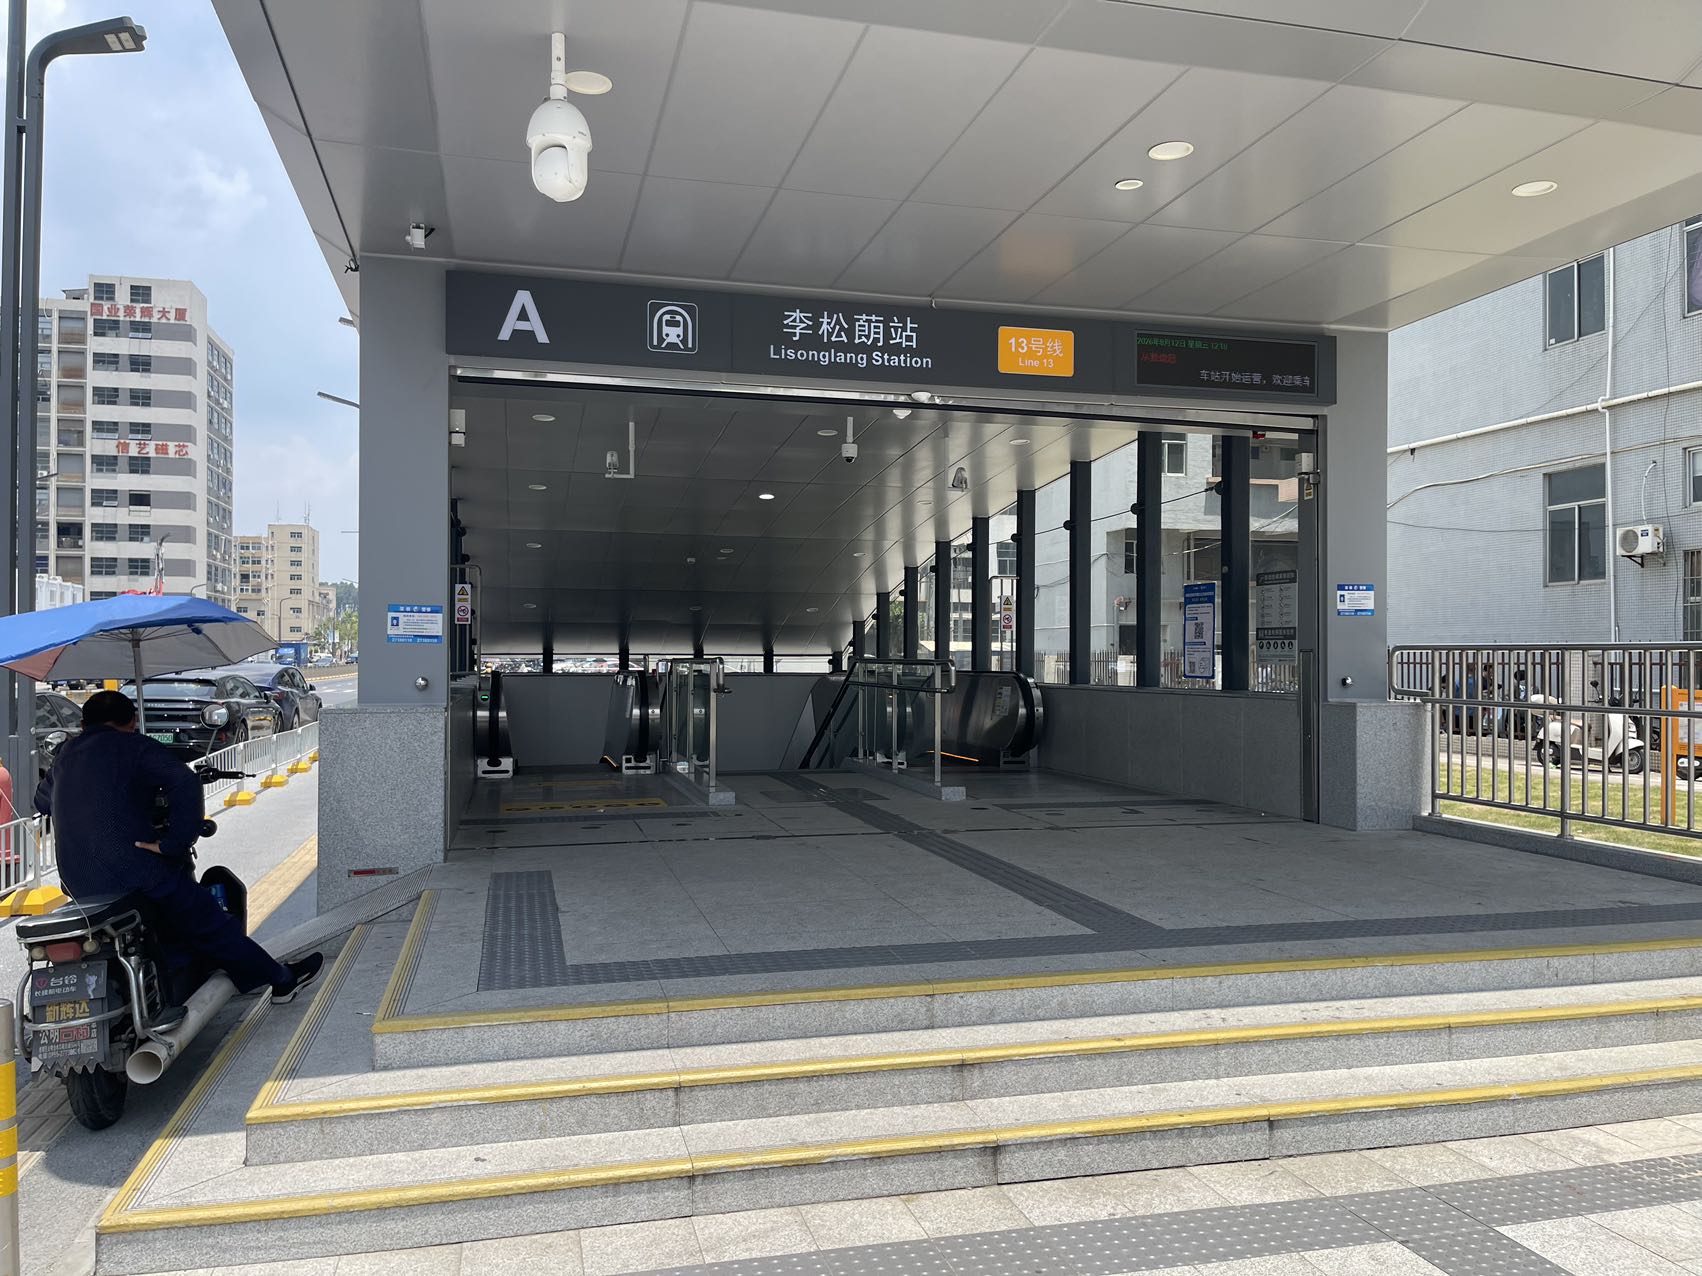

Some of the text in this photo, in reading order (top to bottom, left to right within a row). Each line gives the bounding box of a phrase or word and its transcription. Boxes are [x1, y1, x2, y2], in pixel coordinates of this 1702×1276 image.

[497, 289, 551, 344] A
[783, 308, 918, 349] 李松蓢站
[770, 345, 932, 369] Lisonglang Station
[1008, 337, 1064, 357] 13号线
[1018, 357, 1054, 368] Line 13
